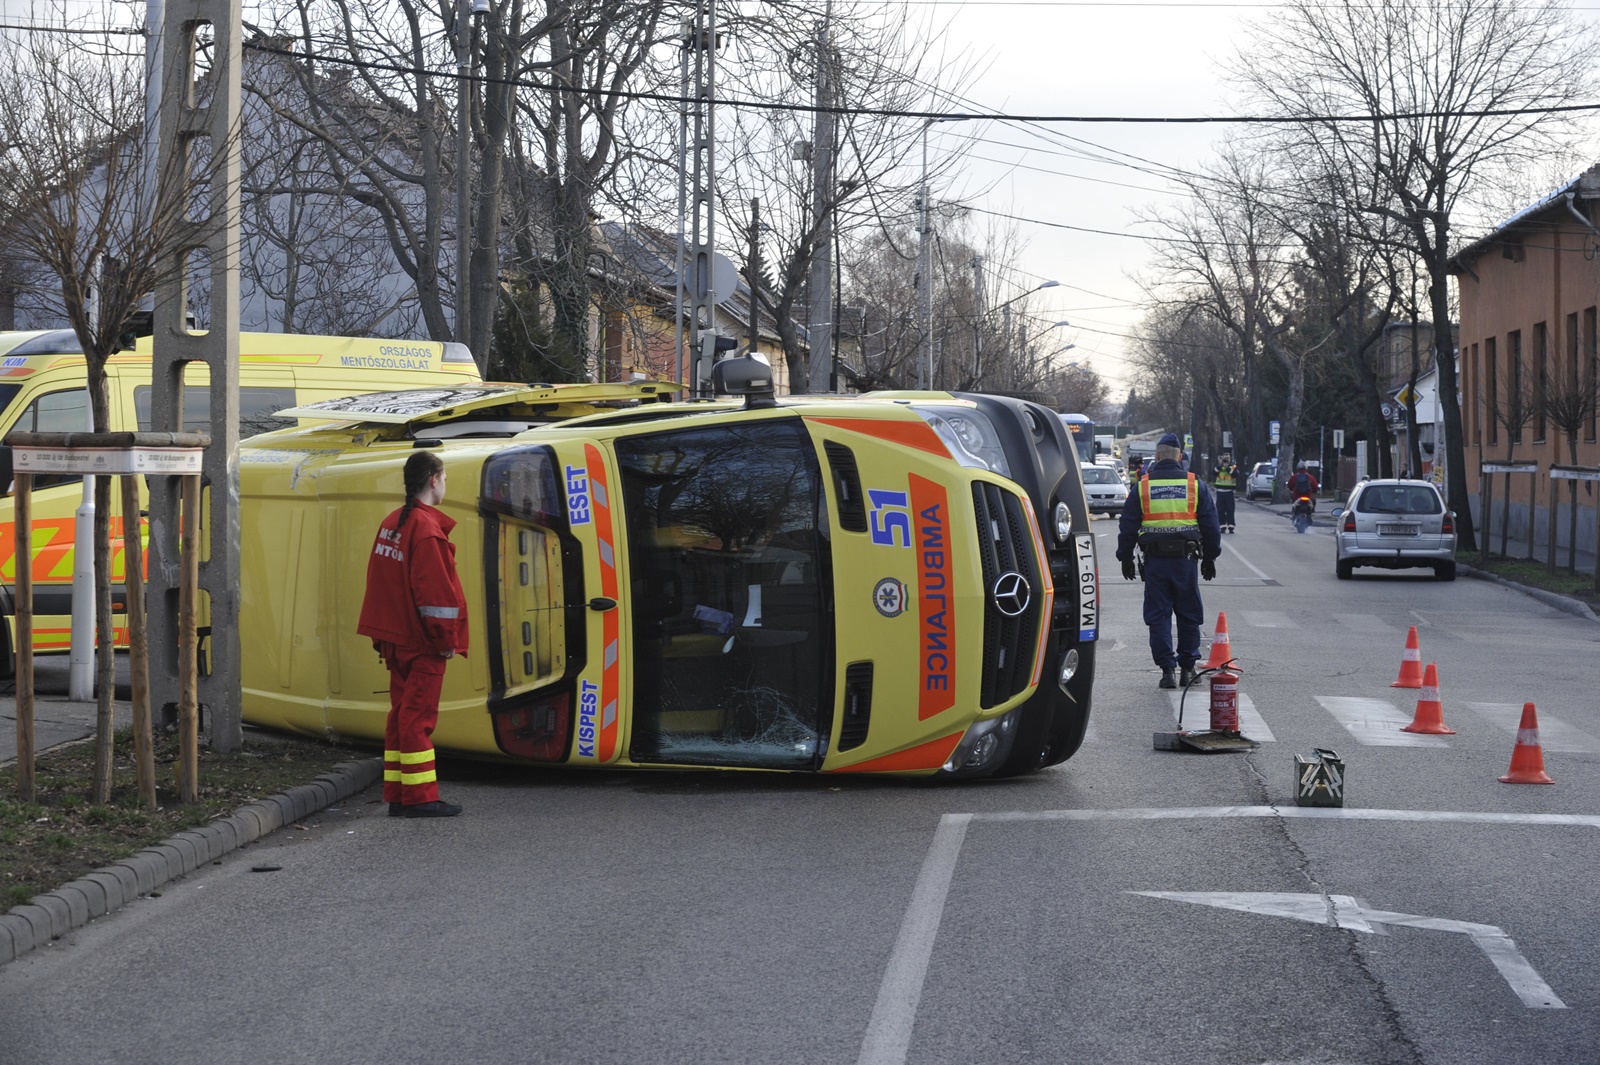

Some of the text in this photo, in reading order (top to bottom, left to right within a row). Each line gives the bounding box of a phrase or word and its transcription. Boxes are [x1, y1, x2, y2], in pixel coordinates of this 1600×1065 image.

[1, 357, 28, 367] KIM
[341, 355, 429, 369] MENTŐSZOLGÁLAT
[380, 345, 432, 358] ORSZÁGOS
[565, 465, 590, 525] ESET
[868, 489, 911, 548] 51
[578, 679, 598, 757] KISPEST
